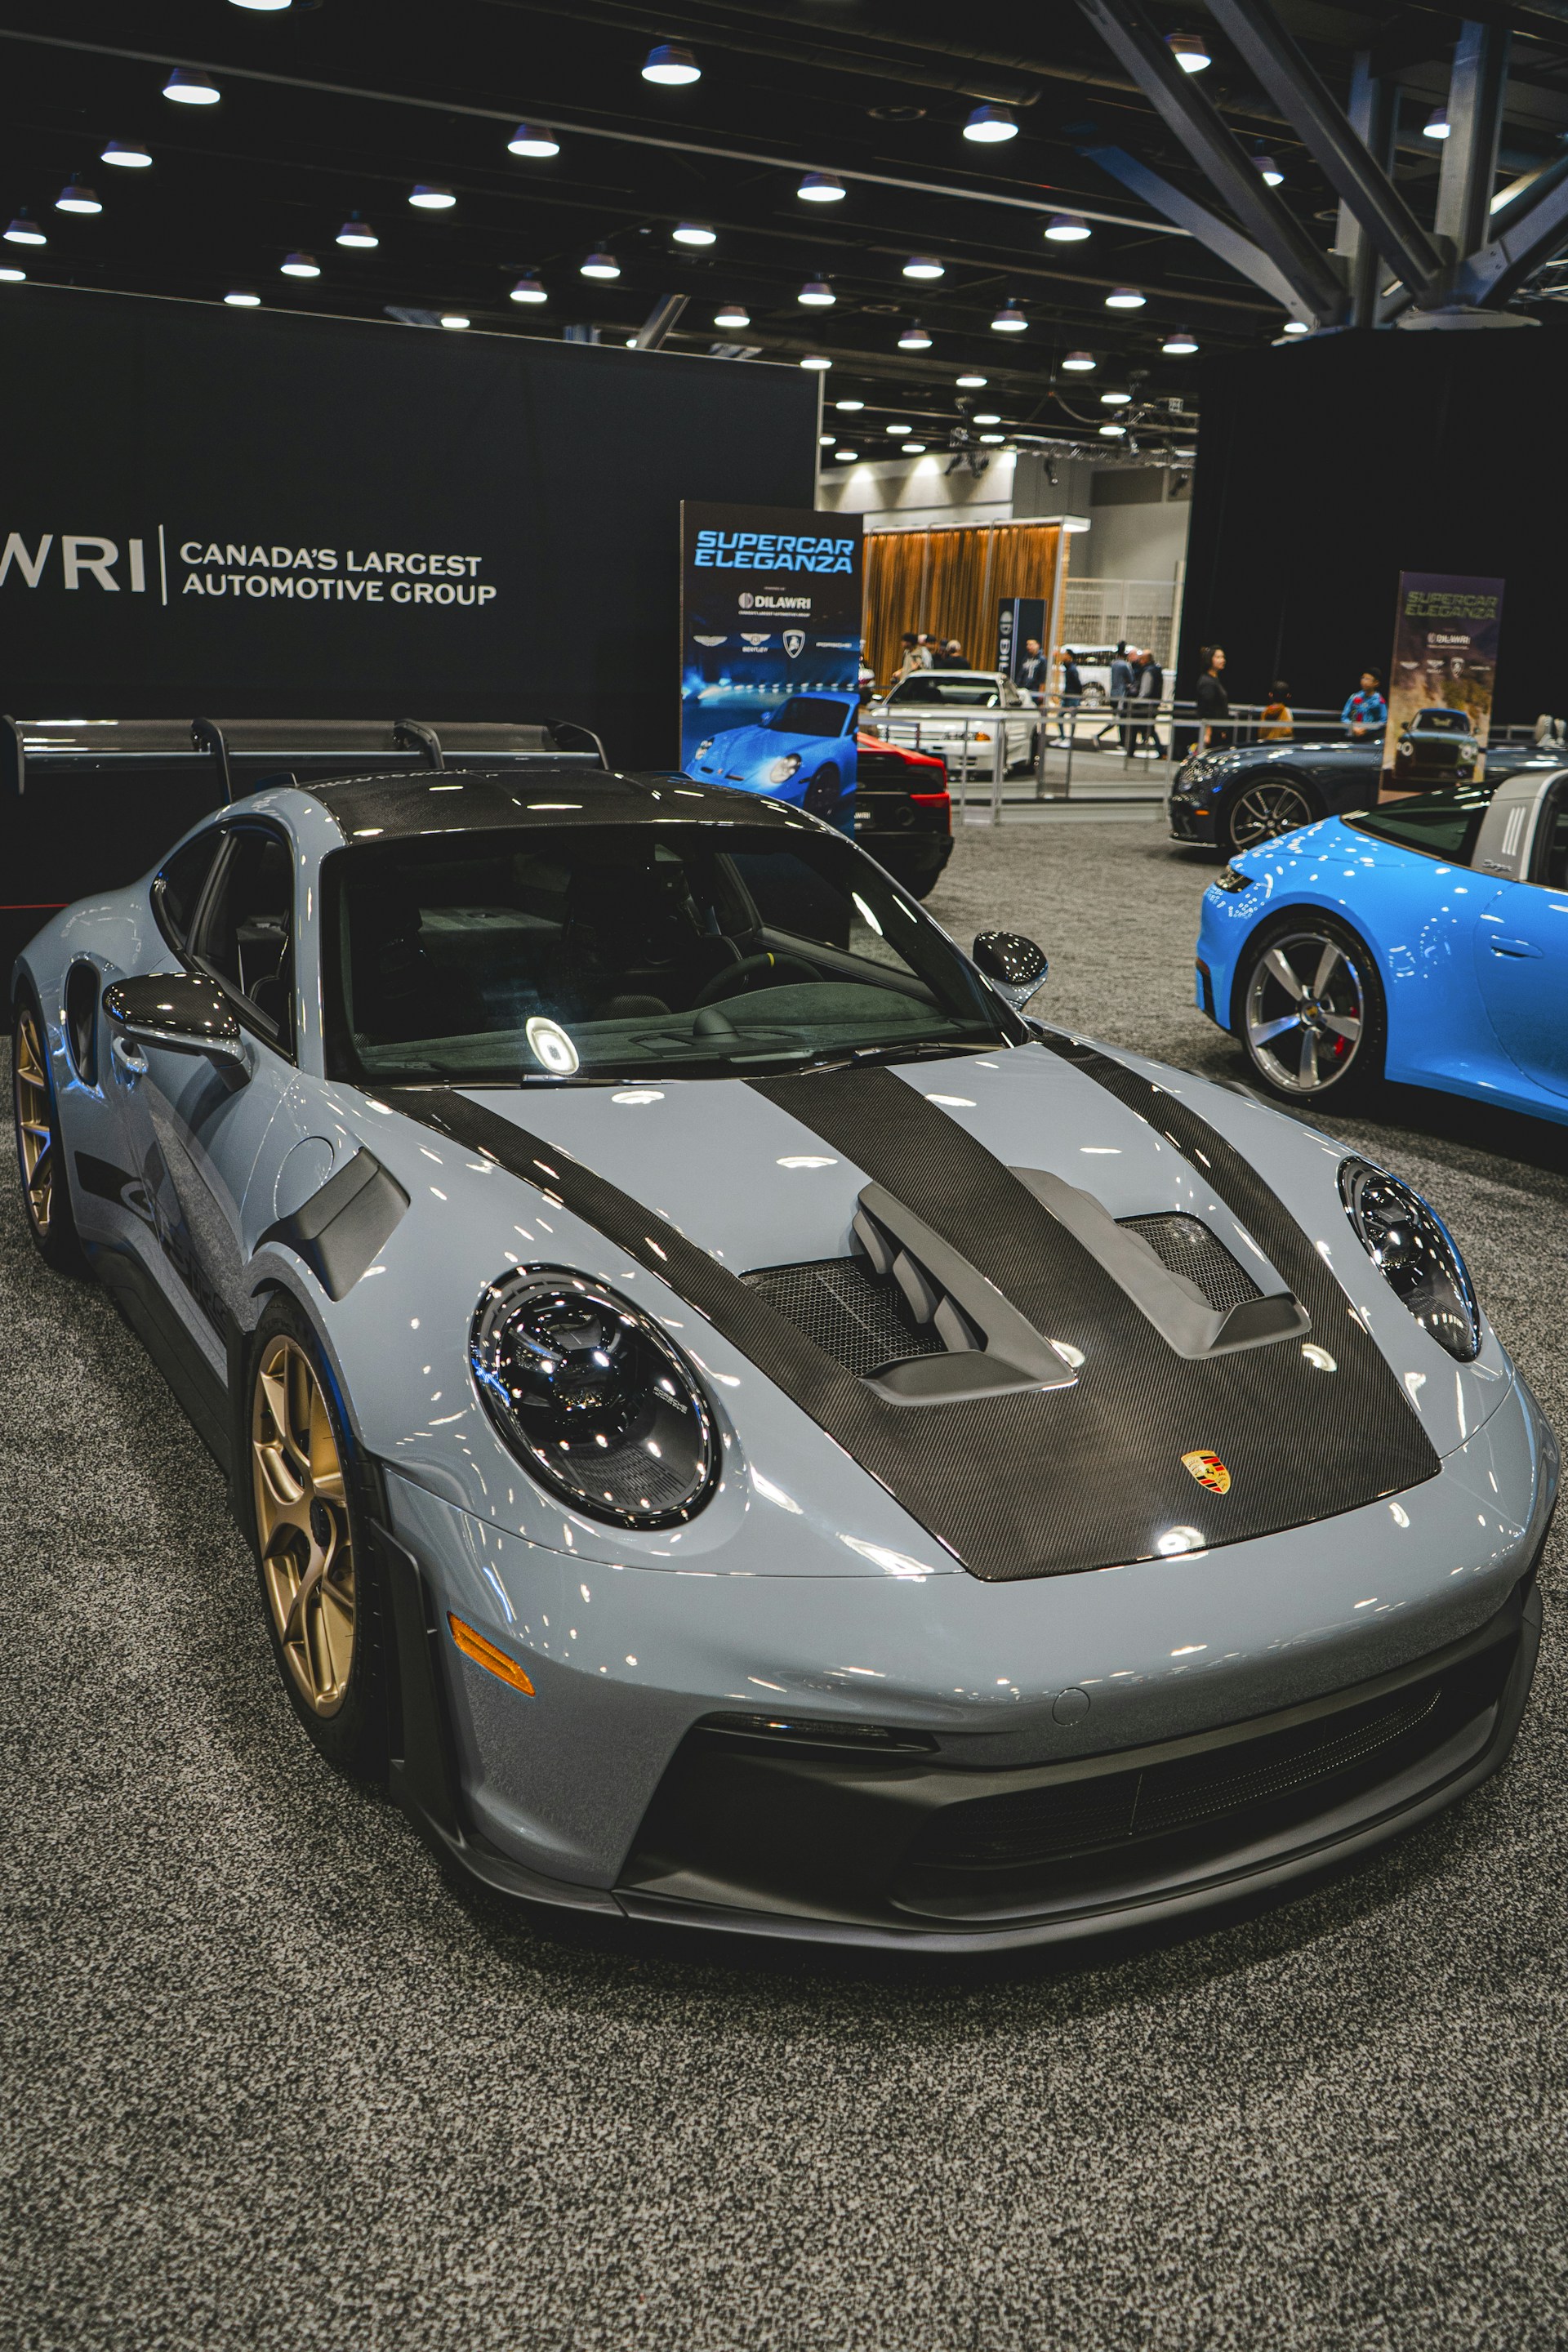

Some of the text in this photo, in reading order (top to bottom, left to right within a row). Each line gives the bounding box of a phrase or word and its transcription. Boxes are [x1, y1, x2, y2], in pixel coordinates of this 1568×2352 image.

[697, 530, 855, 555] SUPERCAR
[180, 541, 483, 577] CANADA'S LARGEST
[694, 549, 853, 573] ELEGANZA
[182, 572, 497, 606] AUTOMOTIVE GROUP
[1407, 590, 1499, 607] SUPERCAR
[755, 595, 812, 609] DILAWRI
[1405, 604, 1496, 619] ELEGANZA
[653, 1386, 688, 1411] PORSCHE
